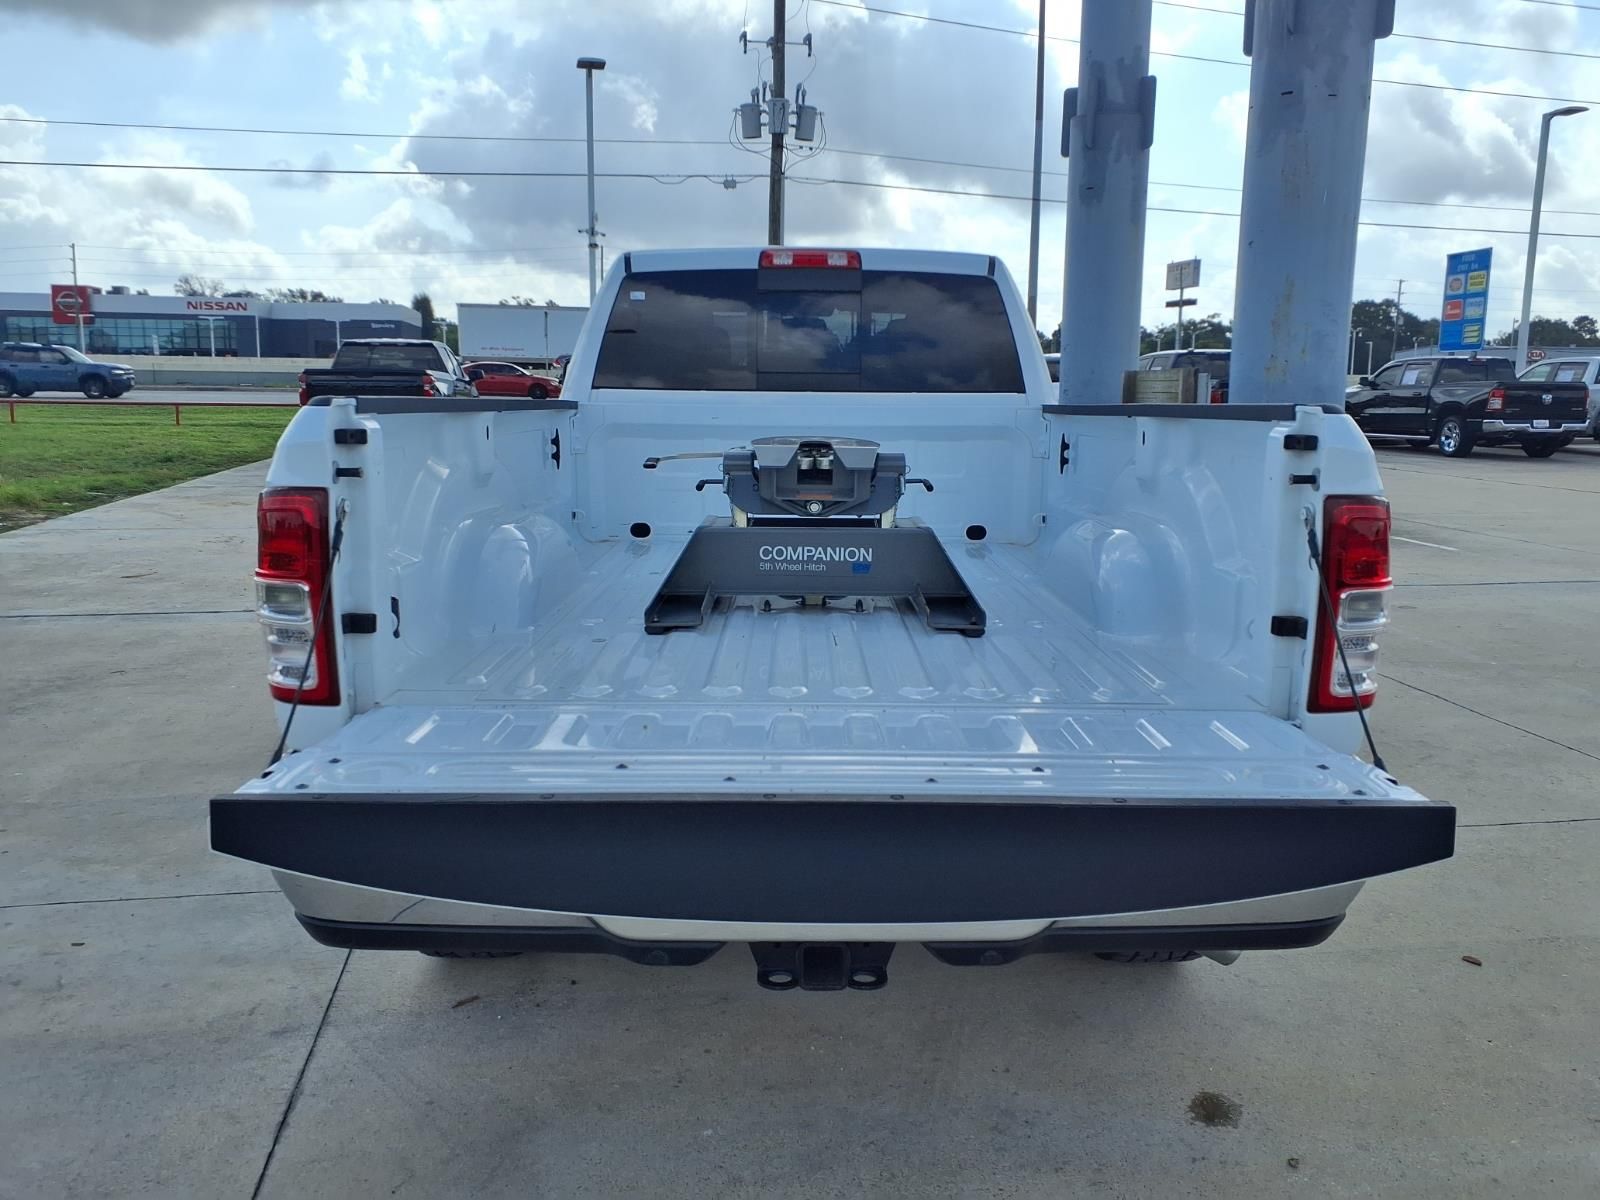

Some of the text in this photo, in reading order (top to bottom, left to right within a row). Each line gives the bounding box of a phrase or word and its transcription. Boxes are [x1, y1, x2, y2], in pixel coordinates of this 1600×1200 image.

[186, 300, 248, 311] NISSAN
[759, 545, 872, 562] COMPANION
[759, 562, 826, 572] 5th Wheel Hitch
